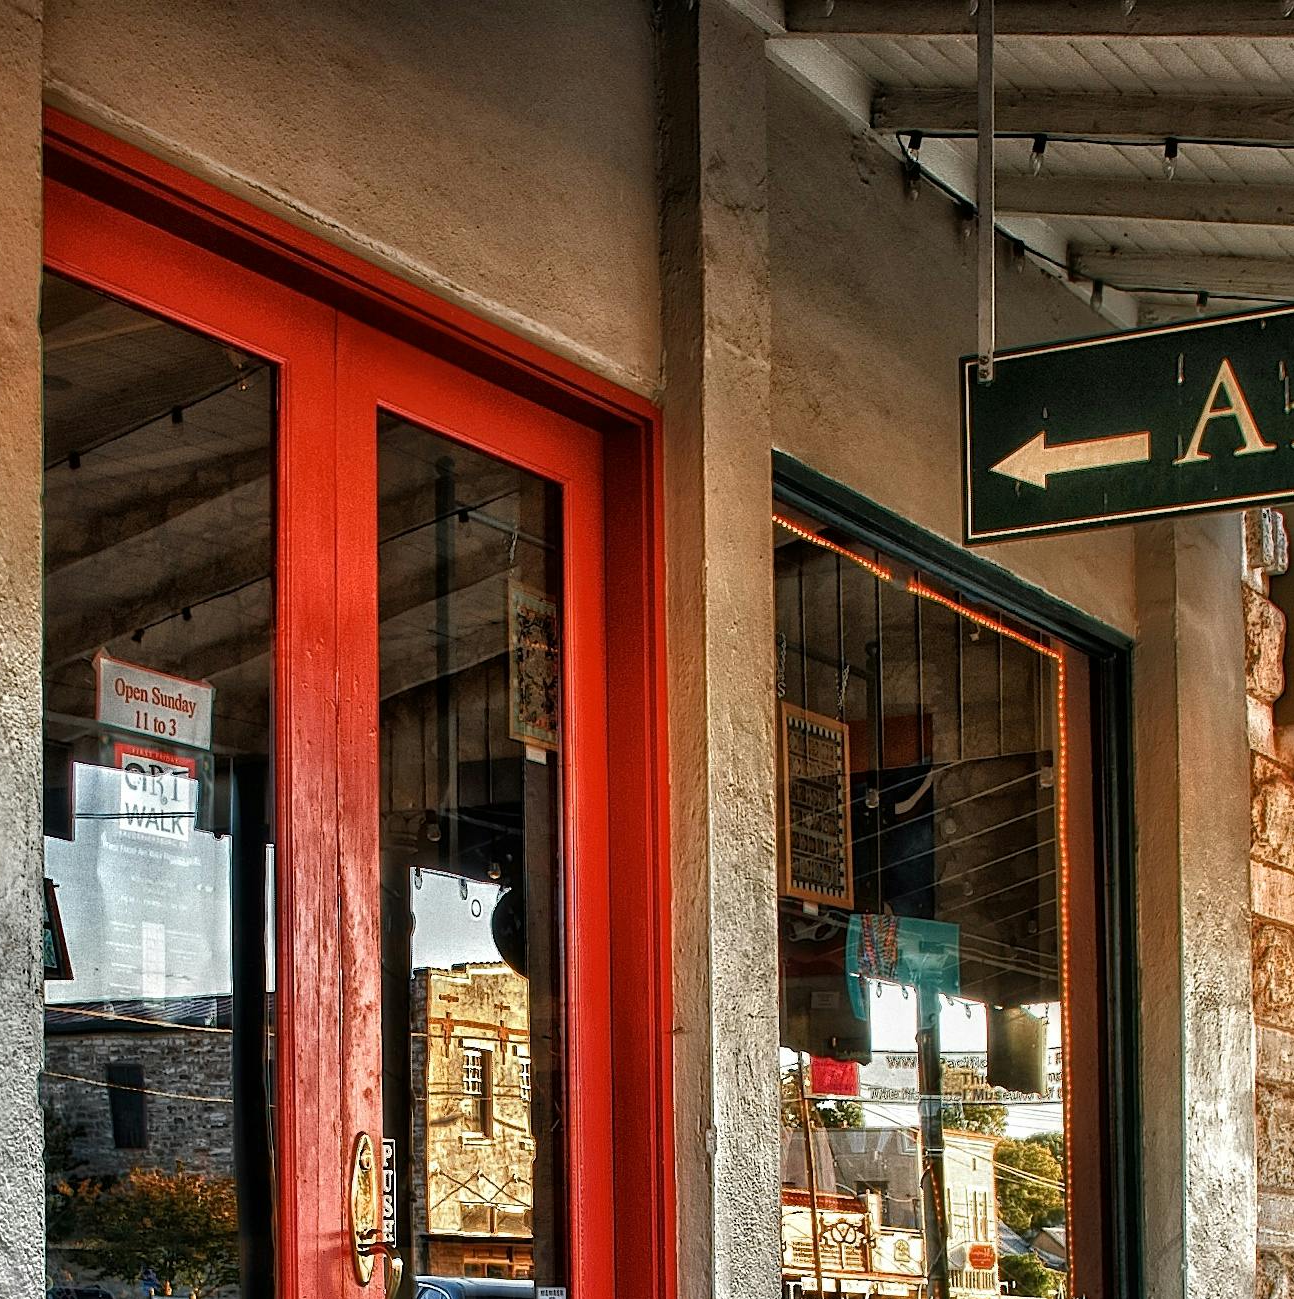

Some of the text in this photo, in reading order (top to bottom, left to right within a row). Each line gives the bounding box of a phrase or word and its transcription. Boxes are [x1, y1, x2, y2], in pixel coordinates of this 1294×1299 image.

[114, 677, 197, 718] Open Sunday
[135, 711, 177, 736] 11 to 3
[124, 802, 185, 836] WALK
